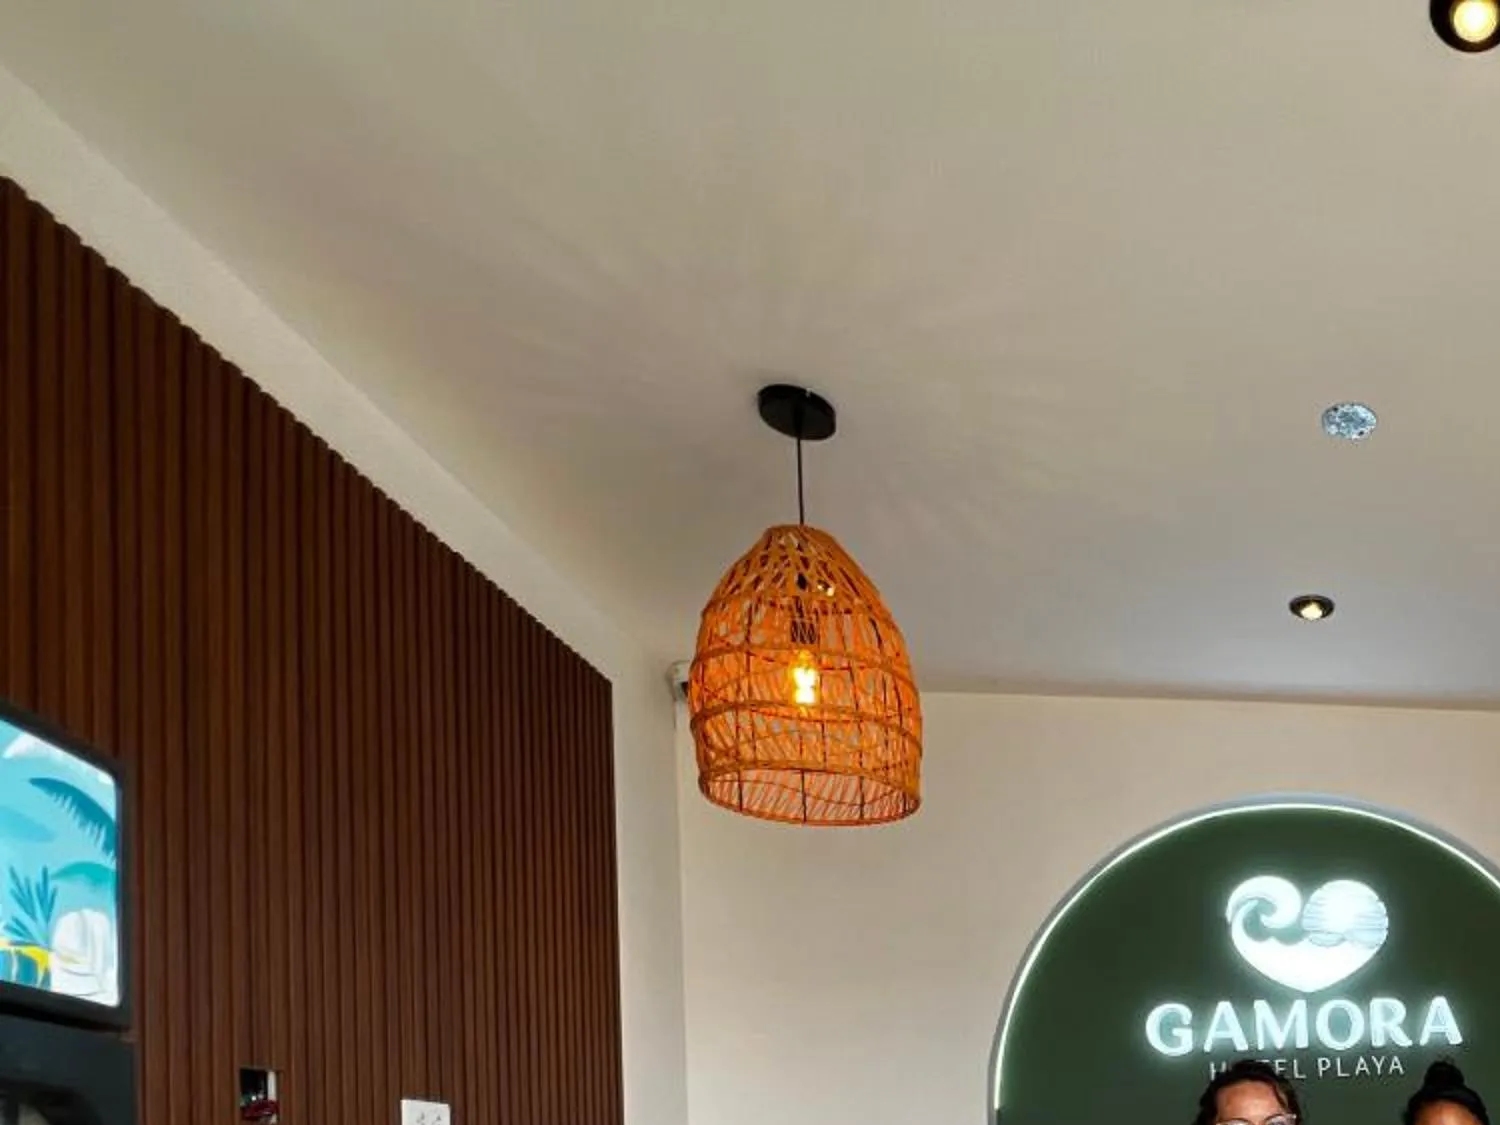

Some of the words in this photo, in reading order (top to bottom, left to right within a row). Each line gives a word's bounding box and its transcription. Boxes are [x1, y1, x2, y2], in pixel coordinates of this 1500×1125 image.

[1145, 996, 1463, 1056] GAMORA
[1209, 1058, 1307, 1081] HEL
[1317, 1055, 1405, 1078] PLAYA
